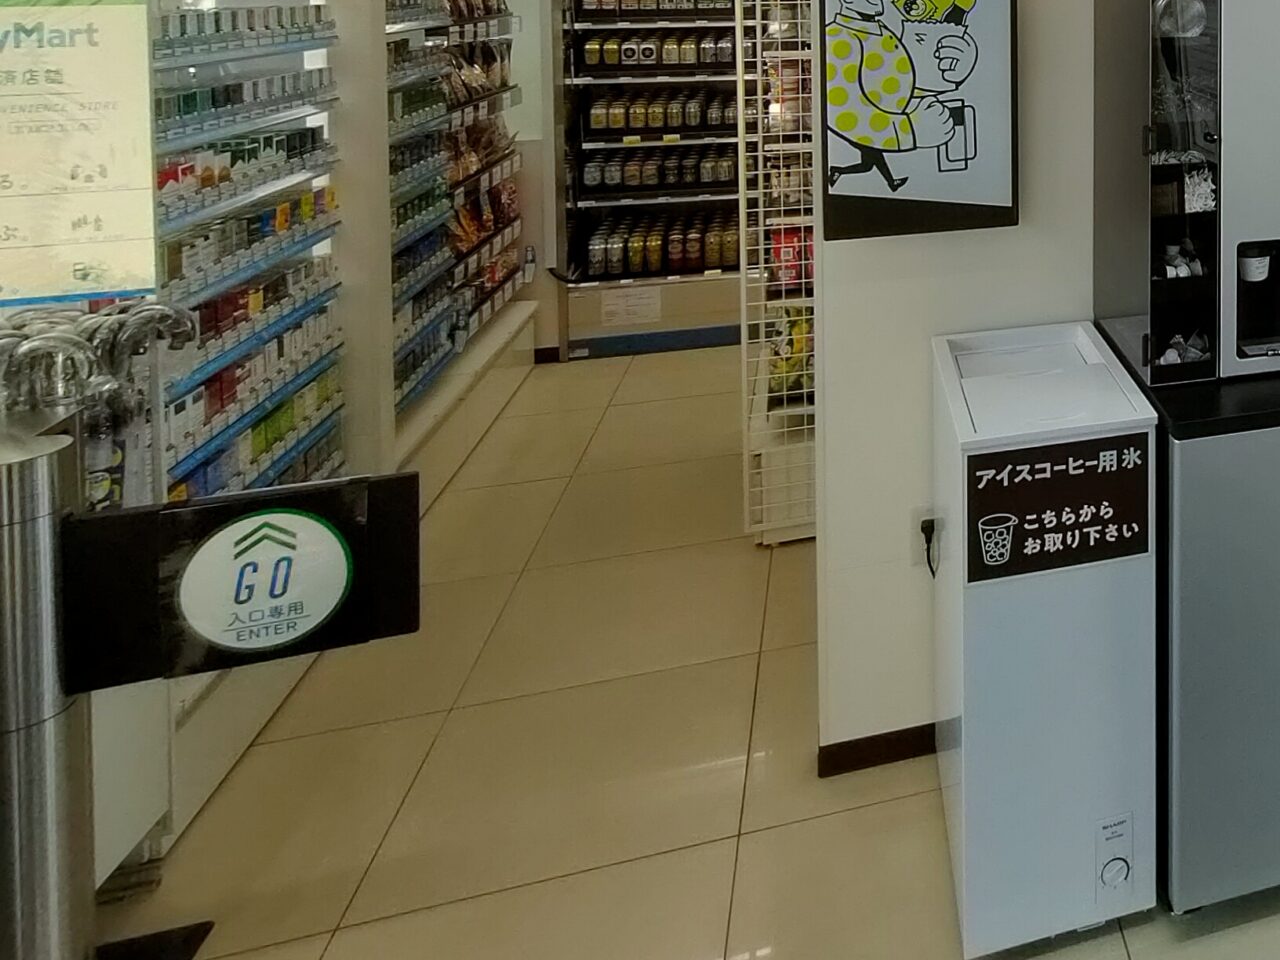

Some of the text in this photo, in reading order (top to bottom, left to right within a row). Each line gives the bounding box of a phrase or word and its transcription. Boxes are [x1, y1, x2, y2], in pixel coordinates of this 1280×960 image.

[975, 446, 1143, 490] アイスコーヒー用氷
[1022, 501, 1115, 531] こちらから
[1022, 522, 1140, 556] お取り下さい
[233, 555, 294, 606] GO
[227, 600, 305, 628] 入口専用
[236, 620, 298, 642] ENTER
